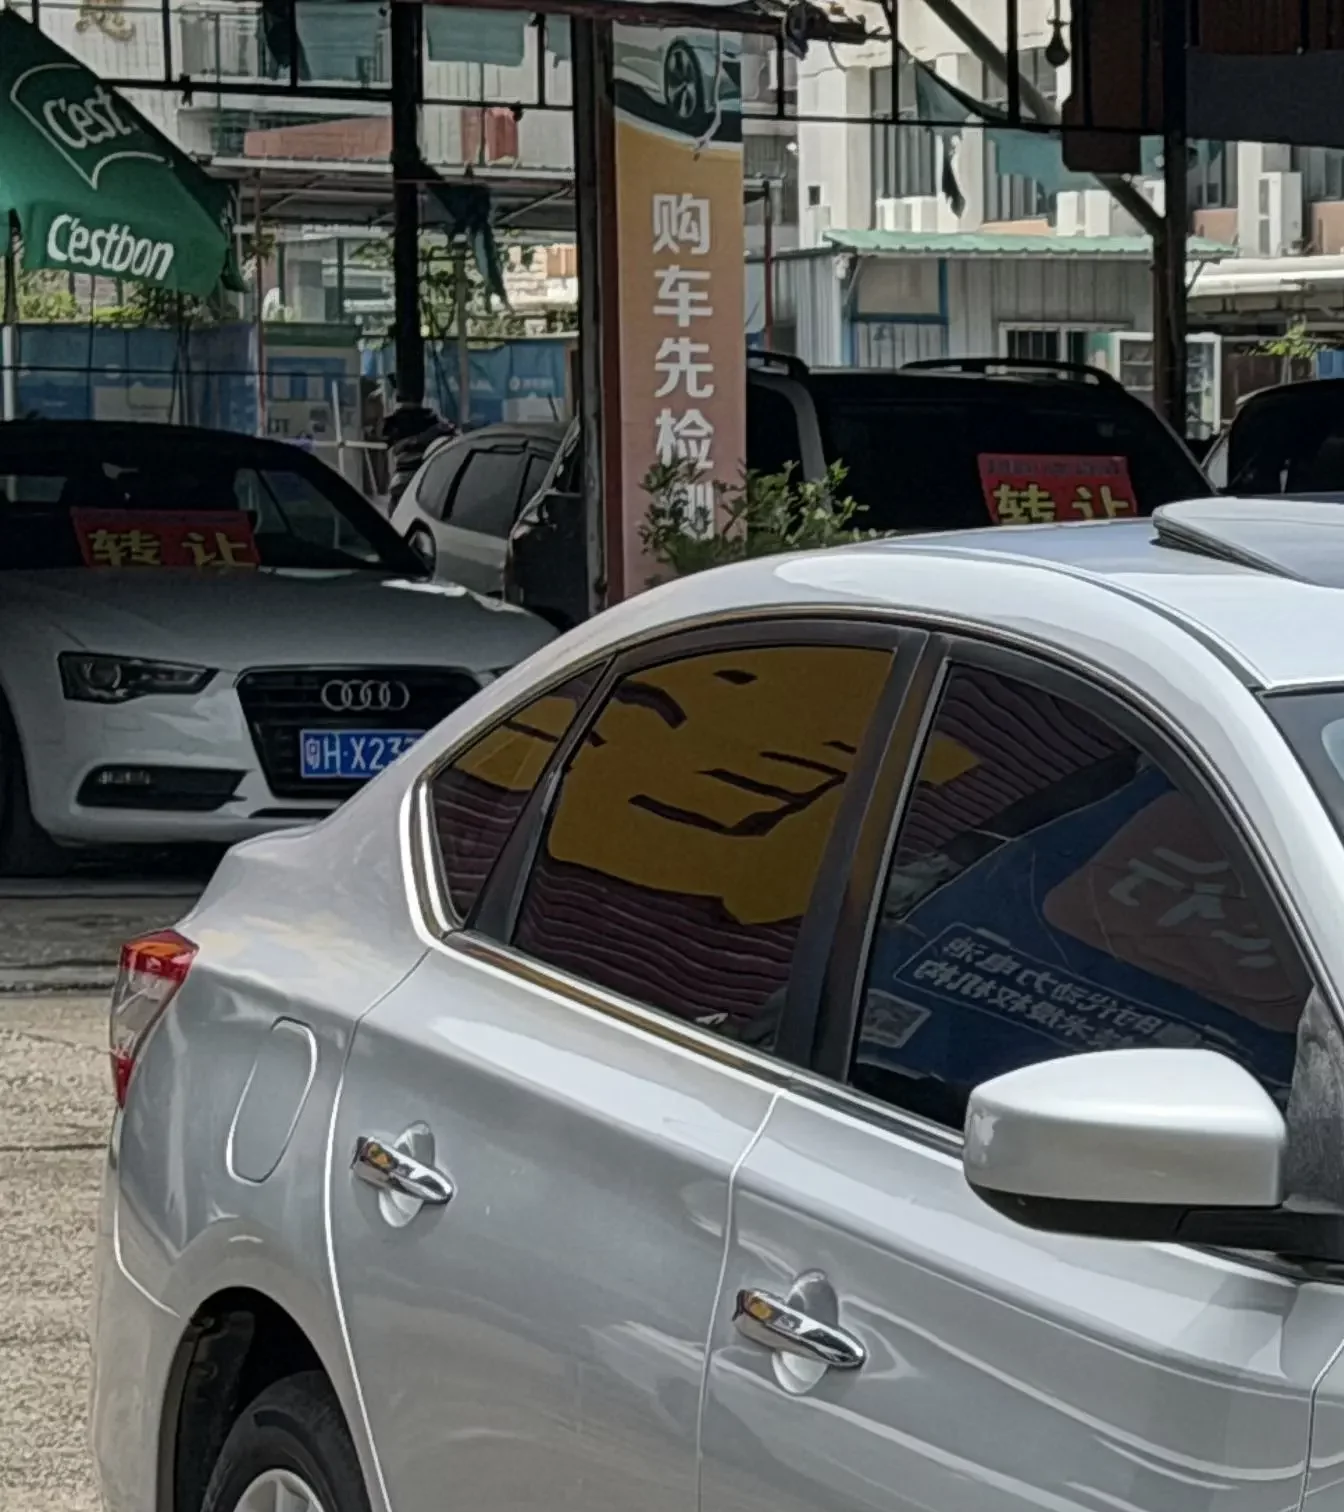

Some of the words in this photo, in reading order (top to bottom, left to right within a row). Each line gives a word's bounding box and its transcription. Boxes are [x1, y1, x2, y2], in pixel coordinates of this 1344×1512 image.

[43, 84, 139, 149] C'est
[47, 214, 175, 281] C'estbon
[992, 483, 1130, 524] 转让
[88, 529, 255, 568] 转让
